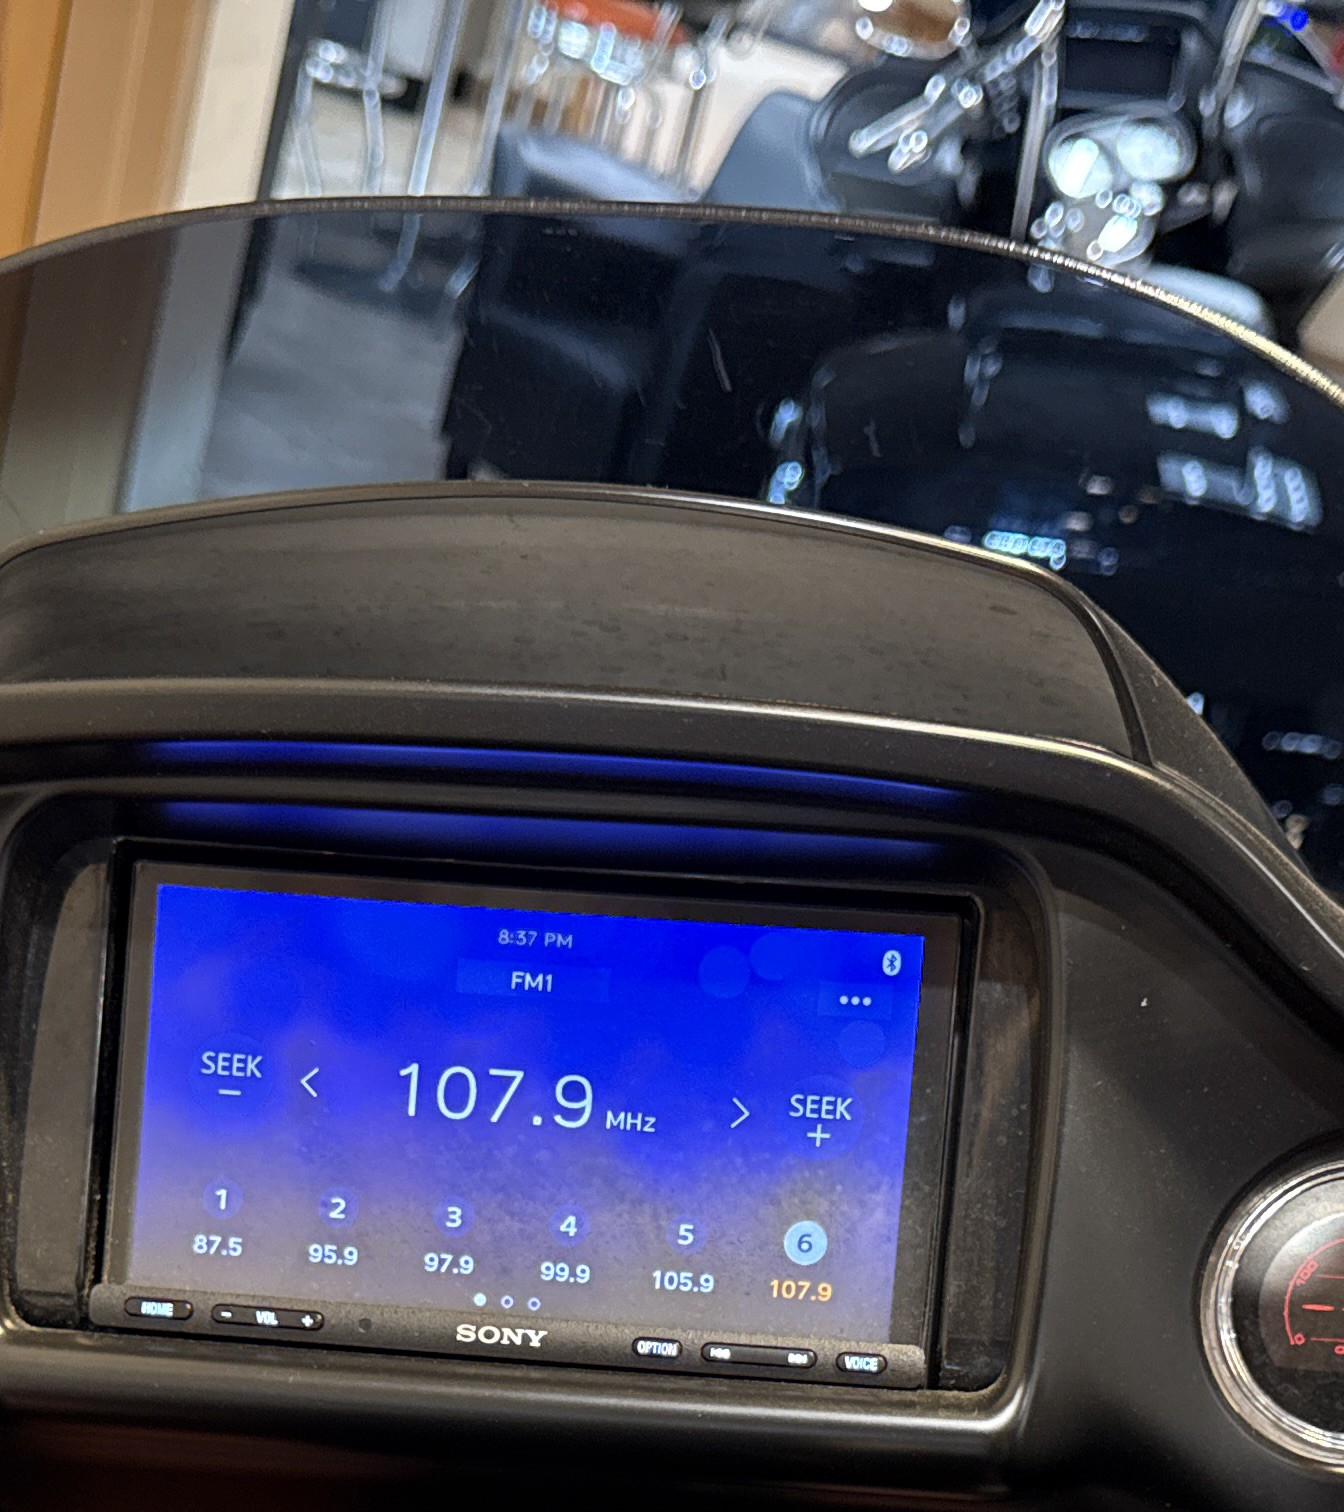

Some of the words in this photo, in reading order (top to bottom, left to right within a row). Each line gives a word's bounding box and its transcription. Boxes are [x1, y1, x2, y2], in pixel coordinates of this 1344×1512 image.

[497, 929, 538, 947] 8:37
[544, 932, 573, 949] PM
[511, 971, 553, 992] FM1
[200, 1051, 264, 1079] SEEK
[399, 1062, 594, 1129] 107.9
[605, 1111, 657, 1134] MHz
[788, 1093, 854, 1121] SEEK
[214, 1188, 228, 1211] 1
[328, 1197, 347, 1219] 2
[445, 1206, 463, 1228] 3
[559, 1215, 578, 1237] 4
[677, 1223, 694, 1246] 5
[796, 1233, 813, 1254] 6
[192, 1234, 243, 1257] 87.5
[307, 1243, 359, 1266] 95.9
[423, 1252, 475, 1275] 97.9
[540, 1261, 591, 1284] 99.9
[652, 1269, 715, 1293] 105.9
[769, 1278, 833, 1301] 107.9
[1295, 1259, 1319, 1287] 100
[141, 1301, 174, 1317] HOME
[256, 1310, 279, 1327] VOL
[456, 1323, 548, 1348] SONY
[1293, 1332, 1306, 1346] 0
[636, 1340, 679, 1357] OPTION
[844, 1355, 879, 1371] VOICE
